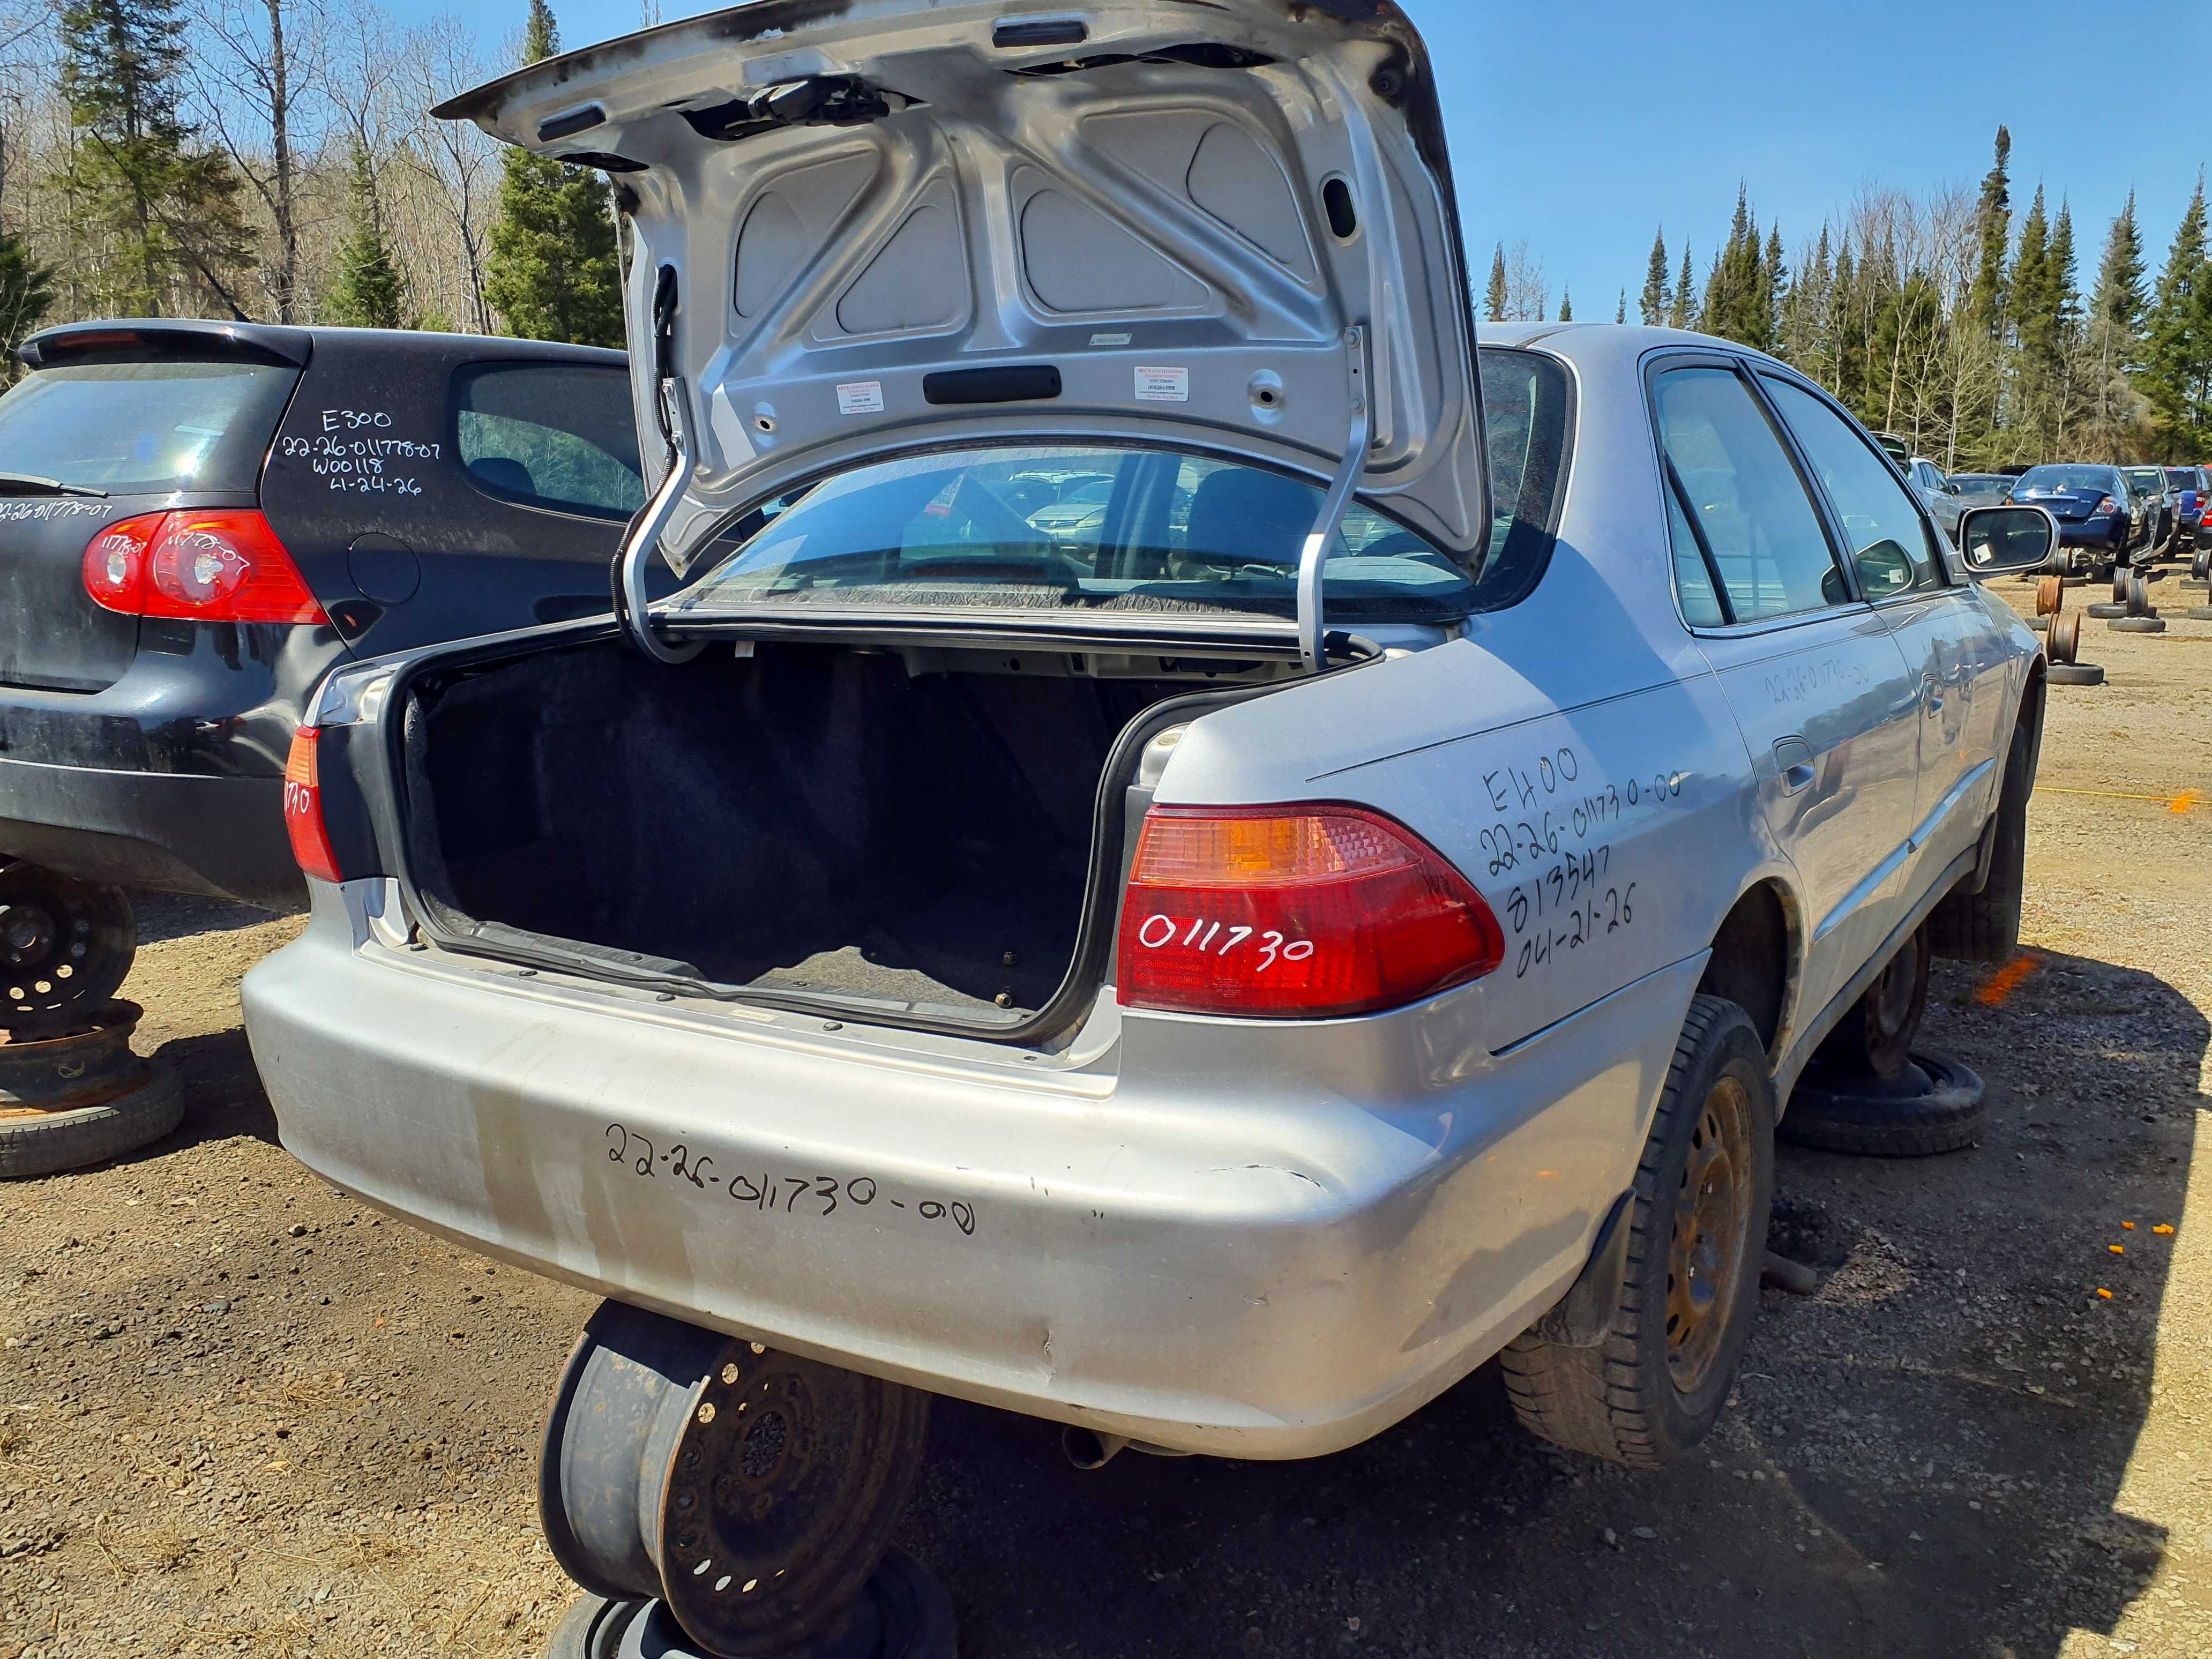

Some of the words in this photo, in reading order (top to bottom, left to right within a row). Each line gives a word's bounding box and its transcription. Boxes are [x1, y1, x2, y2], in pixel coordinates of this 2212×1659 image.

[322, 410, 392, 432] E300
[283, 436, 440, 459] 22-26-011778-07
[330, 476, 422, 496] 4-24-26
[0, 502, 113, 522] 2-26-011778-07
[1507, 845, 1609, 933] 813547
[1139, 914, 1313, 972] 011730
[1517, 882, 1636, 978] 04-21-26
[606, 1123, 975, 1235] 22-26-011730-00
